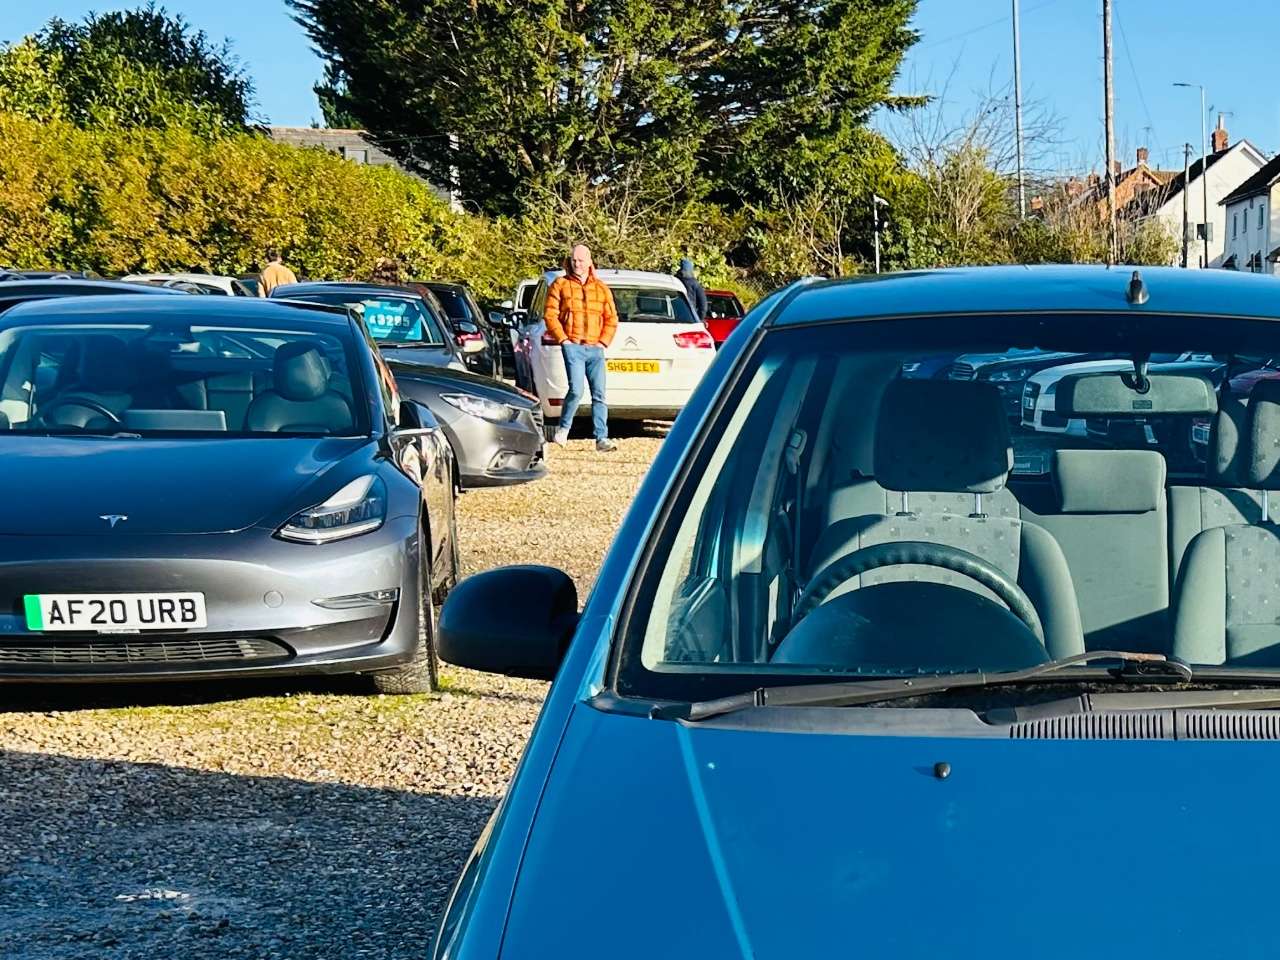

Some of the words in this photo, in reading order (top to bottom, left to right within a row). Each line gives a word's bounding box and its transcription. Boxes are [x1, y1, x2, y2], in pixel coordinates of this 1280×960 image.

[607, 362, 633, 373] SH63
[636, 362, 655, 373] EEY
[49, 599, 128, 624] AF20
[137, 598, 197, 623] URB
